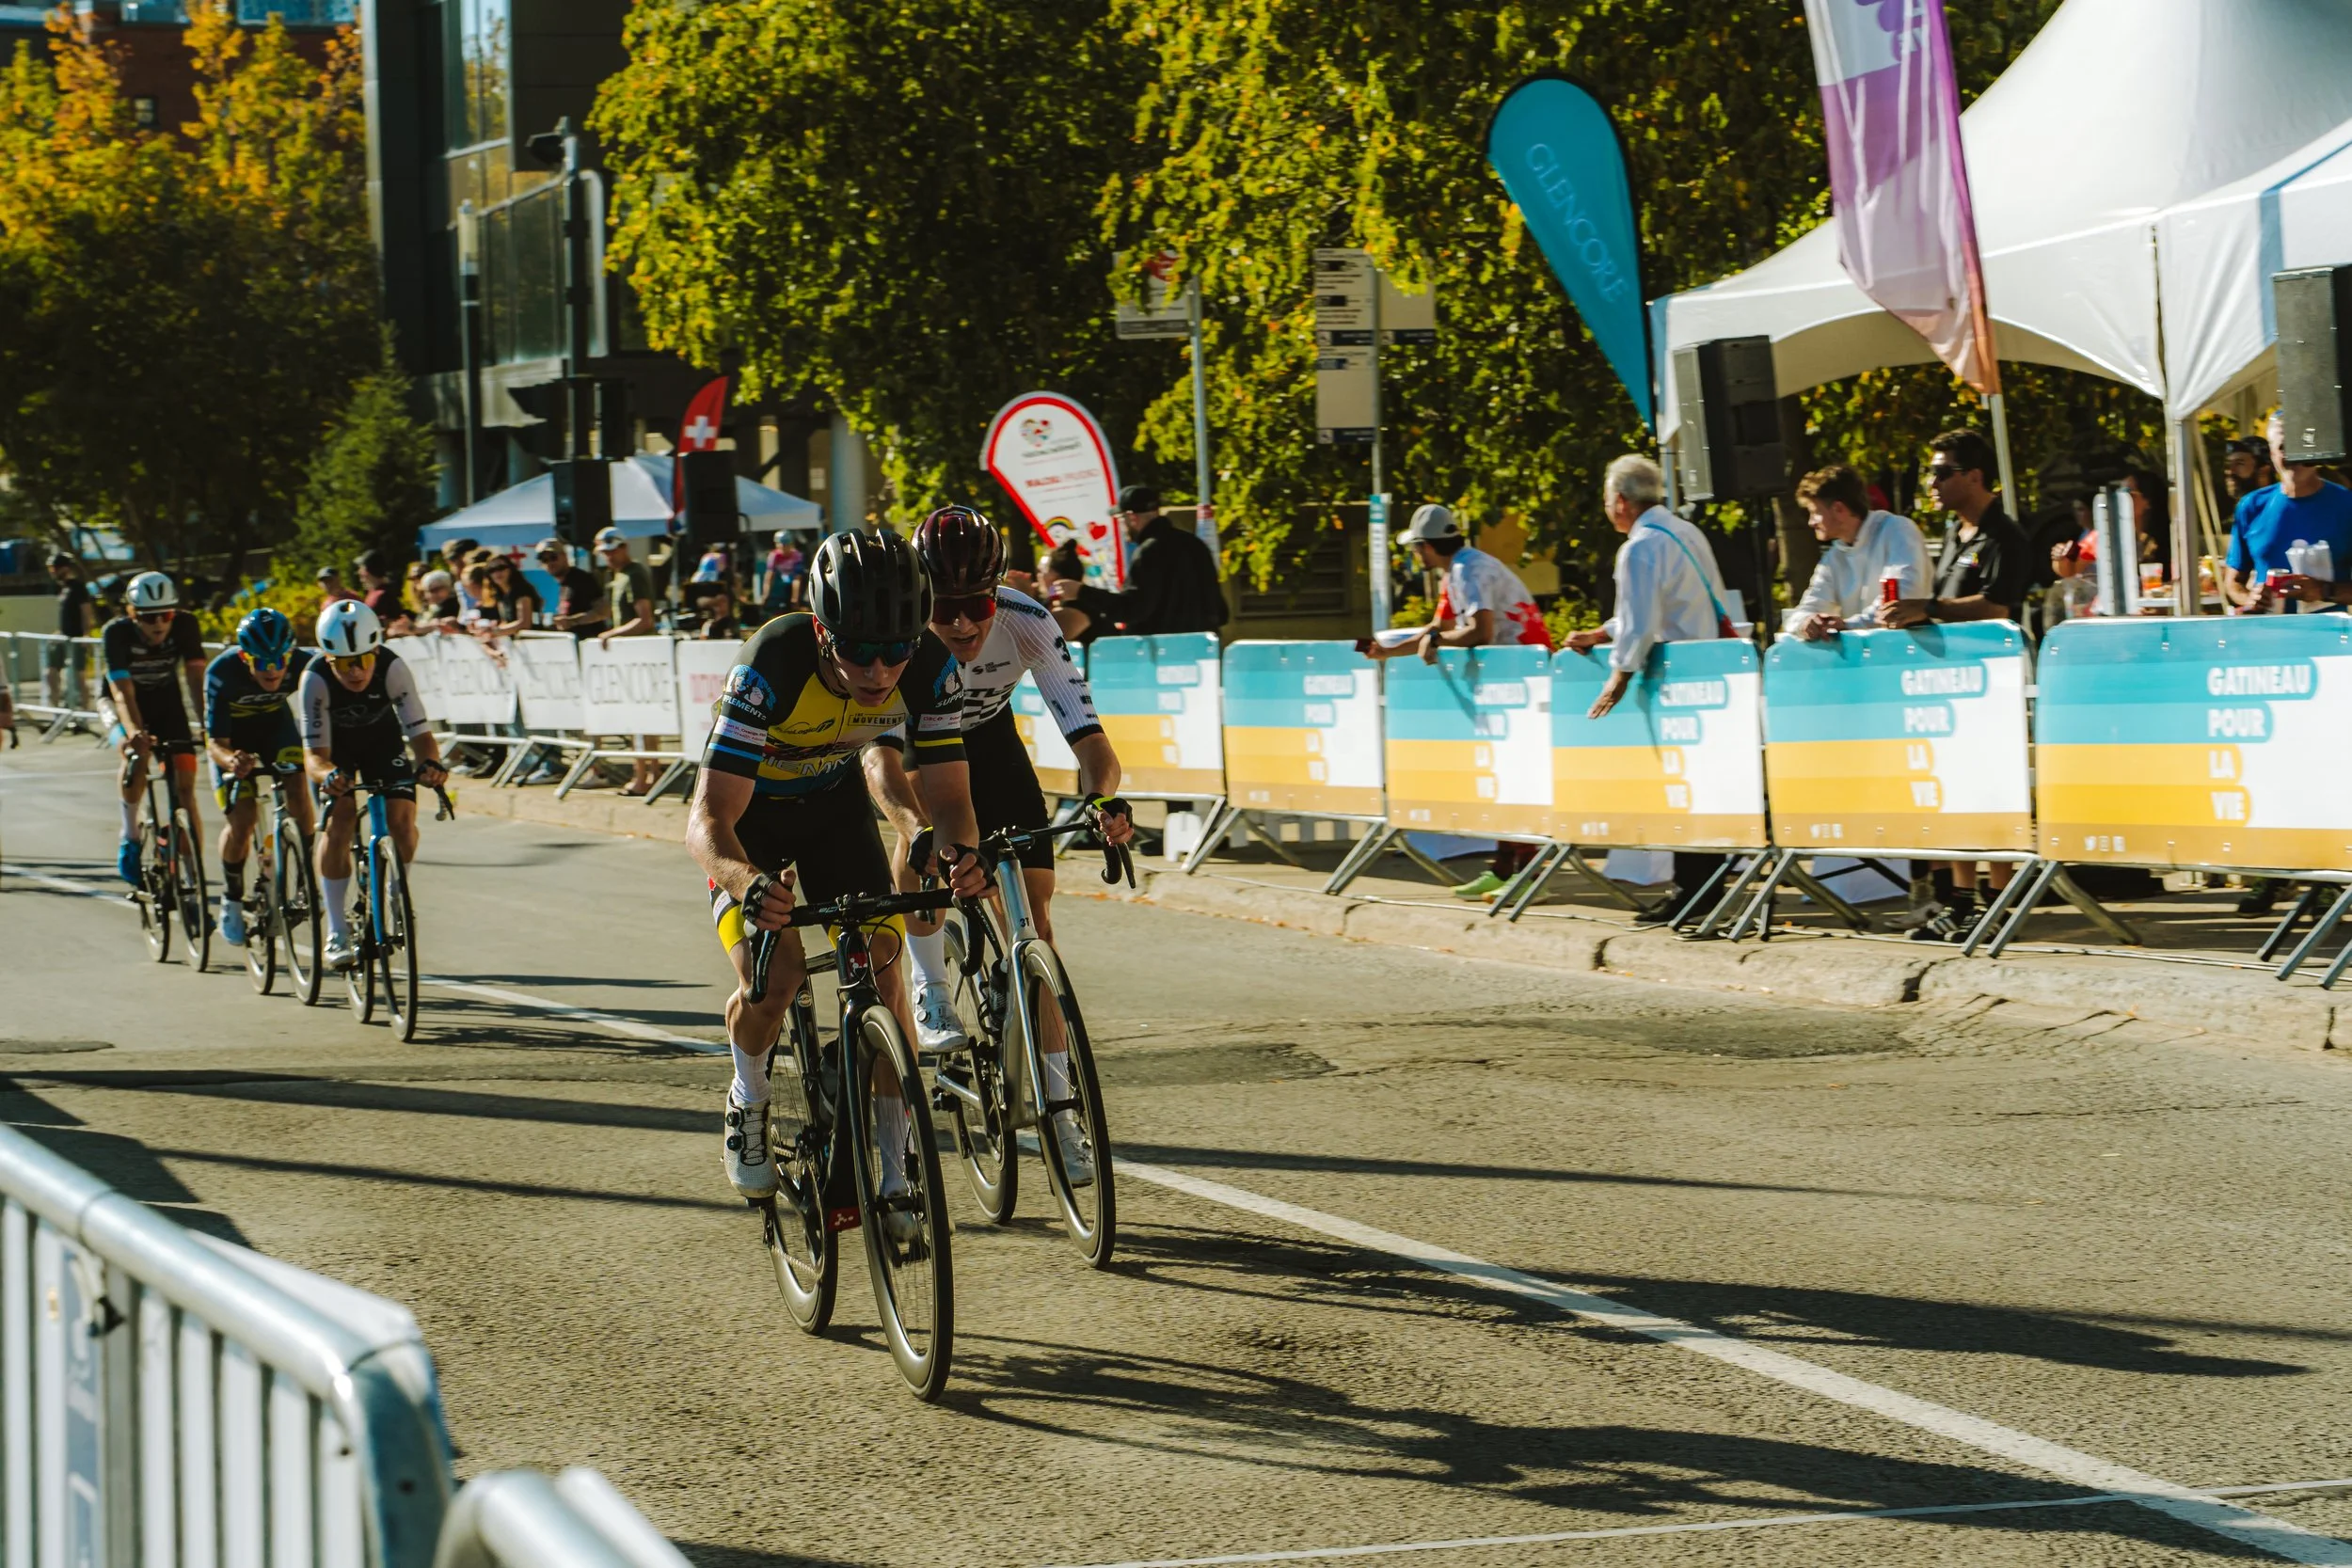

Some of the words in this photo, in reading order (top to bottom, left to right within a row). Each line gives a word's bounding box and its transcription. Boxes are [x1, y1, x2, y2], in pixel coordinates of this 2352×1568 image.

[1525, 143, 1627, 303] GLENCORE
[1901, 665, 1984, 696] GATINEAU
[2207, 665, 2312, 695] GATINEAU
[1902, 705, 1950, 733] POUR
[2207, 708, 2266, 737] POUR
[2209, 750, 2236, 779] LA
[2210, 792, 2246, 820] VIE
